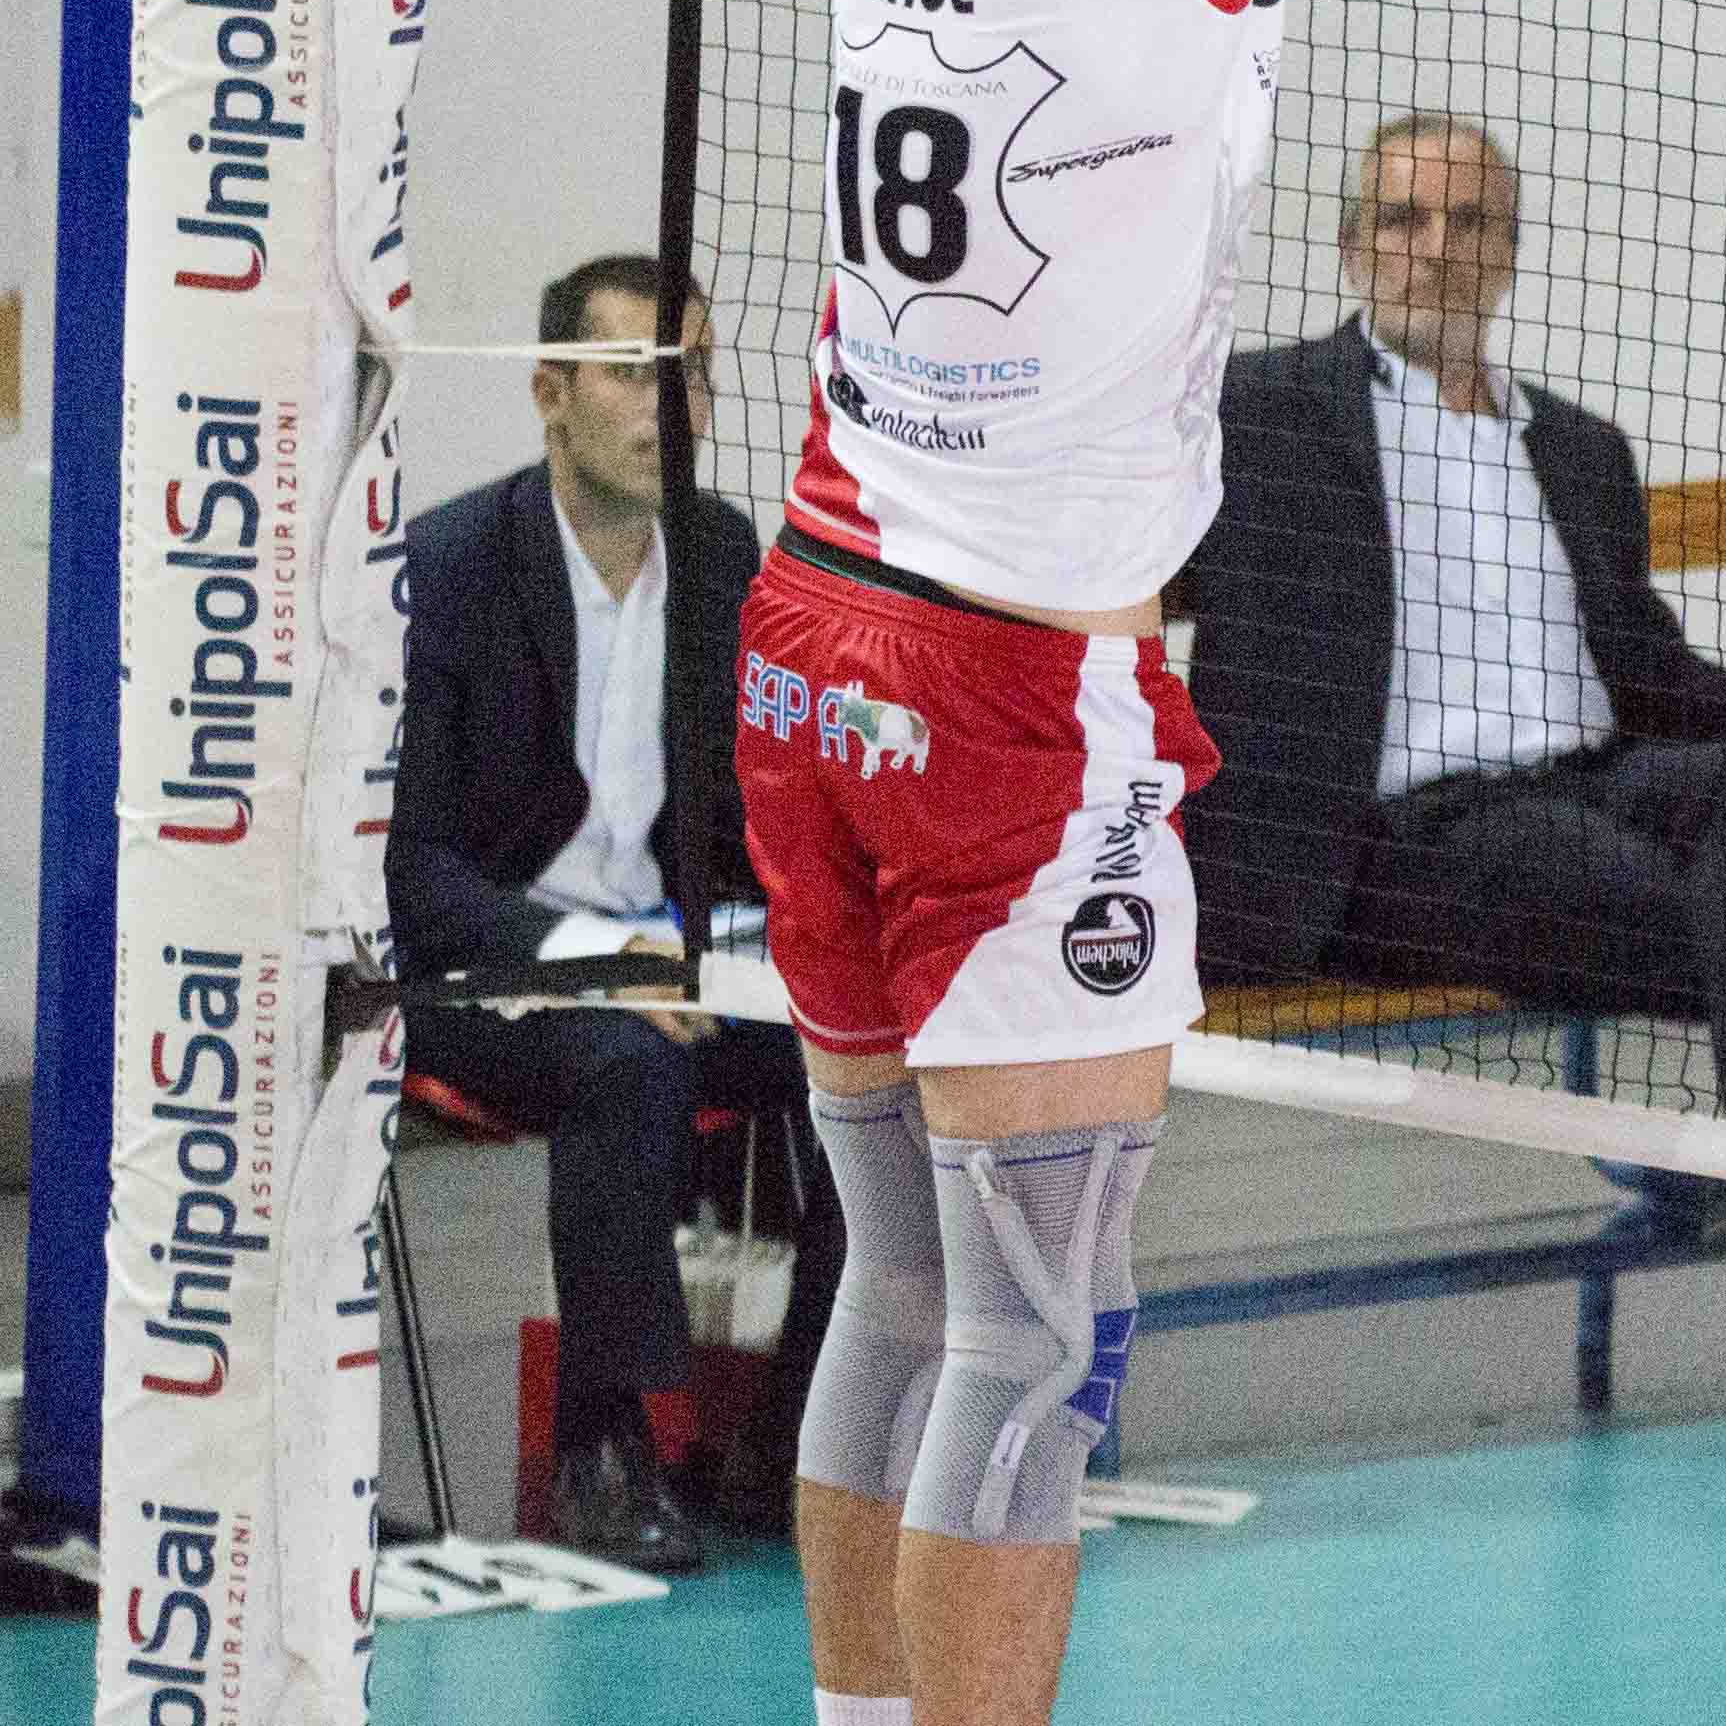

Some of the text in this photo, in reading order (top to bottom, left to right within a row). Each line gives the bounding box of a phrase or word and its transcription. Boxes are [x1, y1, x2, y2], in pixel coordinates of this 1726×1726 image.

[829, 85, 972, 284] 18
[158, 393, 293, 845] UnipolSai
[273, 399, 299, 668] ASSICURAZIONI
[141, 946, 270, 1399] UnipolSai
[250, 951, 281, 1221] ASSICURAZIONI
[127, 1500, 220, 1726] olSai
[219, 1513, 252, 1726] ICURAZIONI
